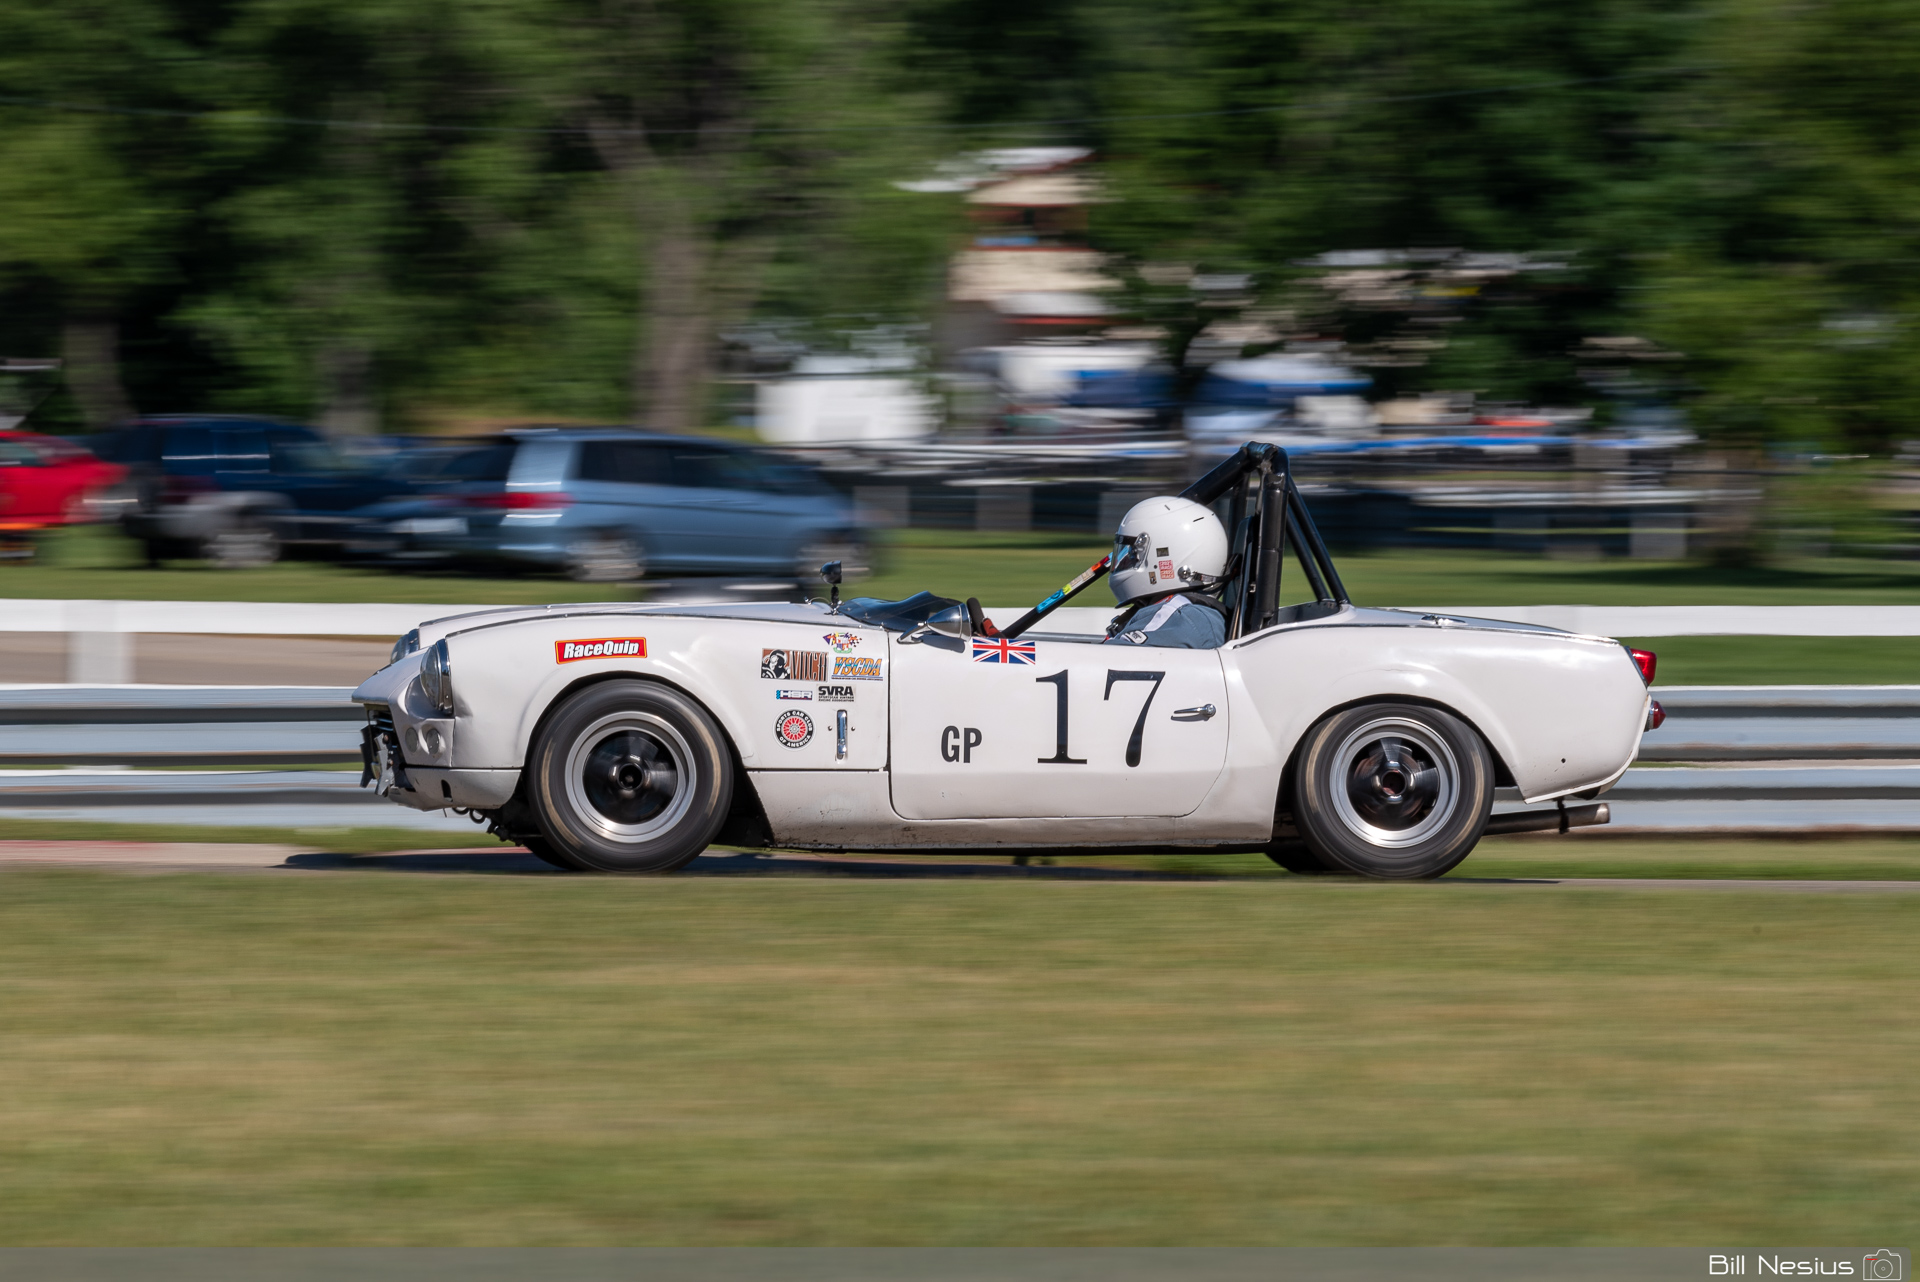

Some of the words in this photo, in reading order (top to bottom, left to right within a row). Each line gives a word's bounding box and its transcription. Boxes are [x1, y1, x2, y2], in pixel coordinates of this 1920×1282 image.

[563, 640, 640, 659] RaceQuip
[833, 656, 882, 676] VSCDA
[818, 686, 854, 696] SVRA
[776, 711, 791, 731] SPORTS
[792, 710, 804, 718] CAR
[804, 716, 813, 732] CLUB
[1035, 669, 1166, 768] 17
[787, 735, 811, 748] AMERICA
[940, 725, 983, 764] GP
